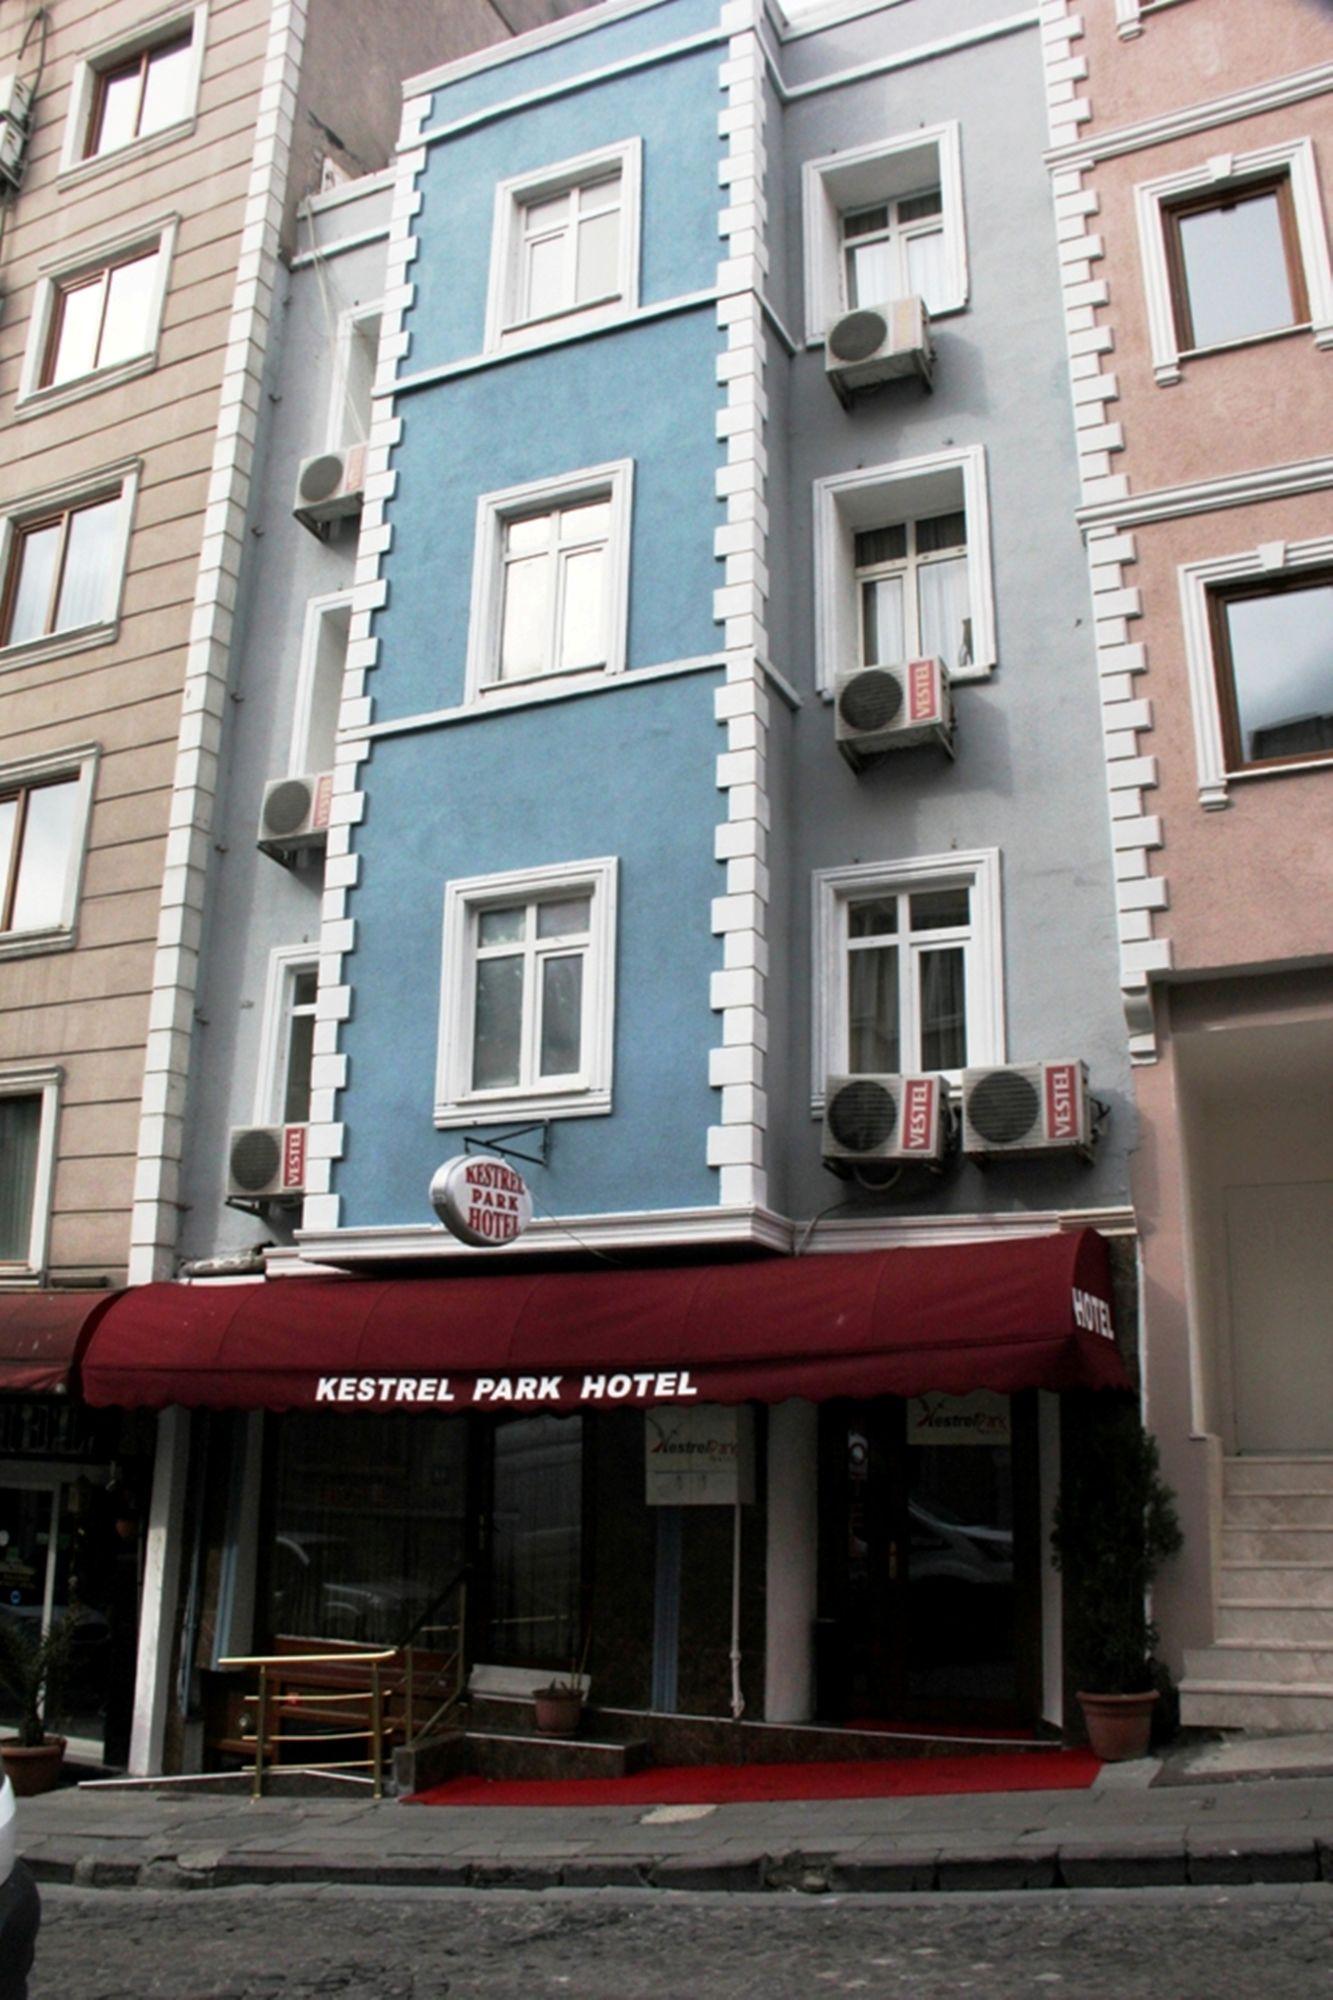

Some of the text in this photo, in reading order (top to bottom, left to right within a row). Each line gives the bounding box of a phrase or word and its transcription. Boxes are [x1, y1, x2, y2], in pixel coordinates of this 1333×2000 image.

[915, 663, 930, 717] VESTEL
[909, 1083, 929, 1147] VESTEL
[1053, 1067, 1072, 1137] VESTEL
[288, 1130, 301, 1185] VESTEL
[465, 1163, 525, 1196] KESTREL
[467, 1206, 522, 1239] HOTEL
[472, 1188, 519, 1212] PARK
[1072, 1287, 1115, 1340] HOTEL
[315, 1372, 698, 1401] KESTREL PARK HOTEL
